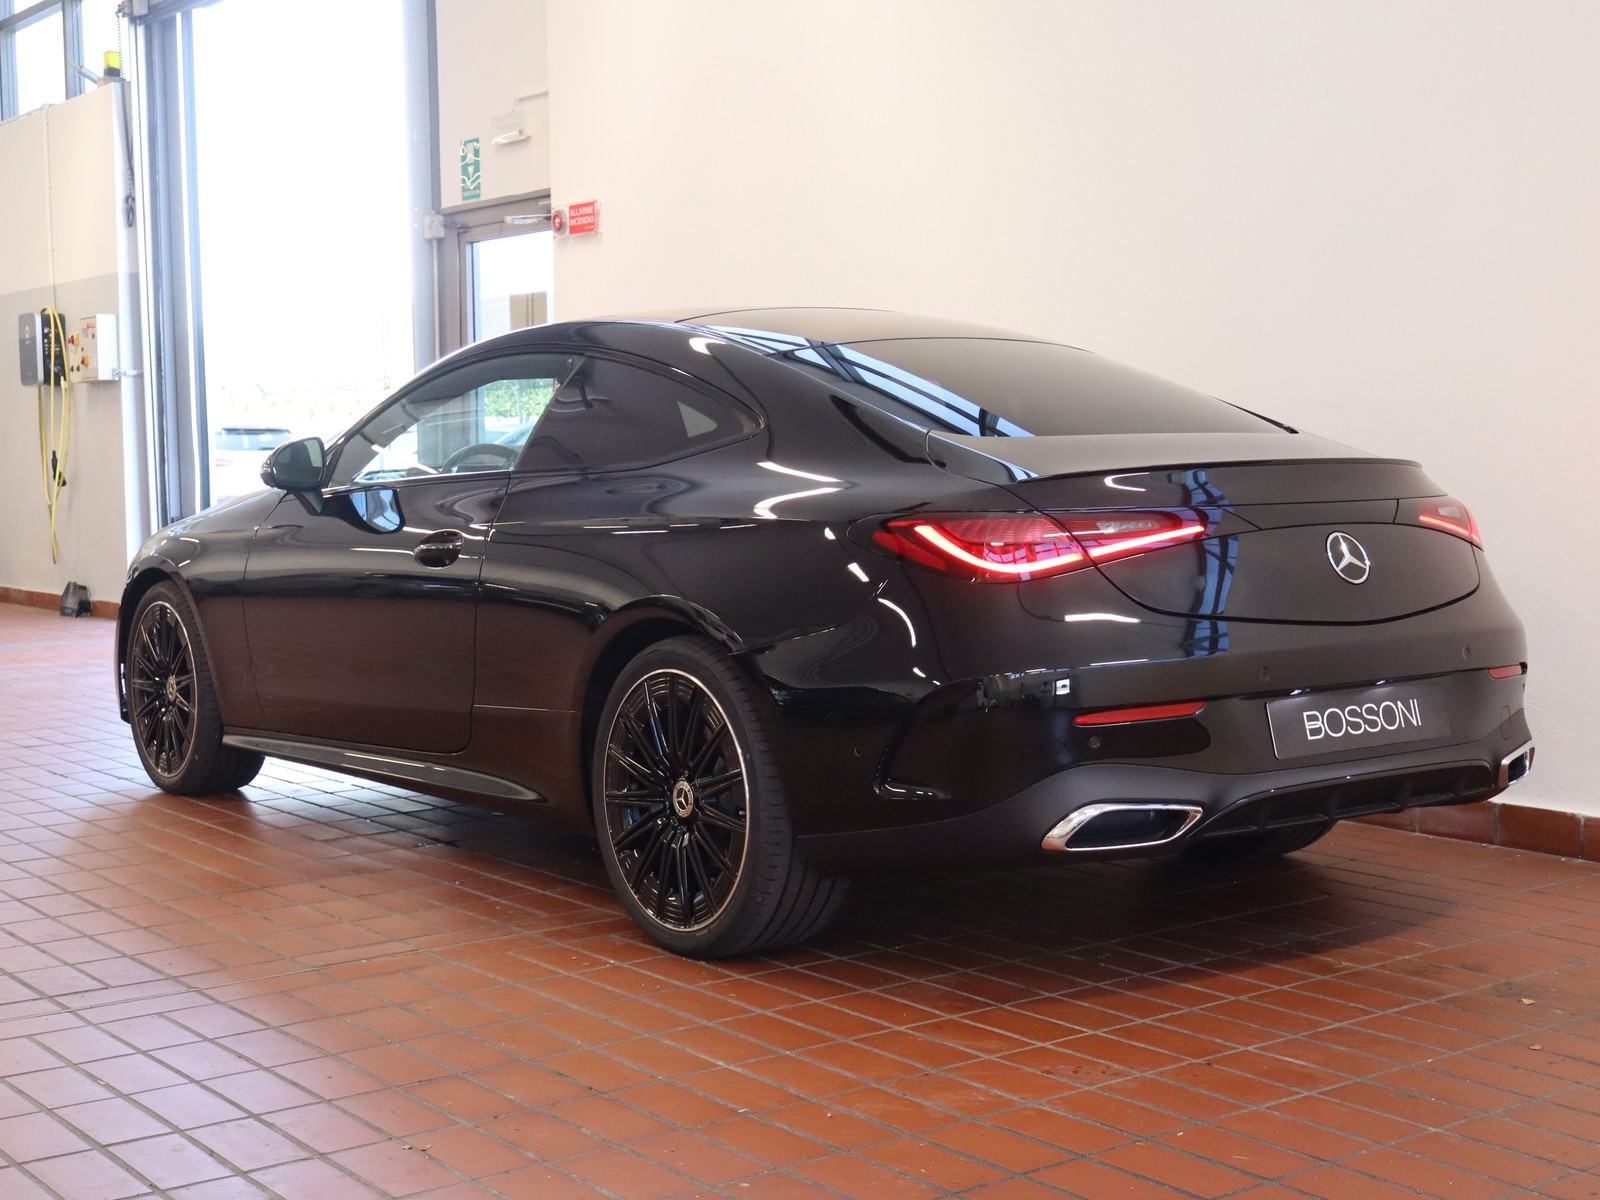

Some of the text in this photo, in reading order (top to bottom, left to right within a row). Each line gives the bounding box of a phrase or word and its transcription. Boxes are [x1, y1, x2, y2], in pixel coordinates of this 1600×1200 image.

[570, 206, 594, 216] ALLARME
[570, 215, 595, 226] INCENDIO
[1303, 699, 1422, 740] BOSSONI
